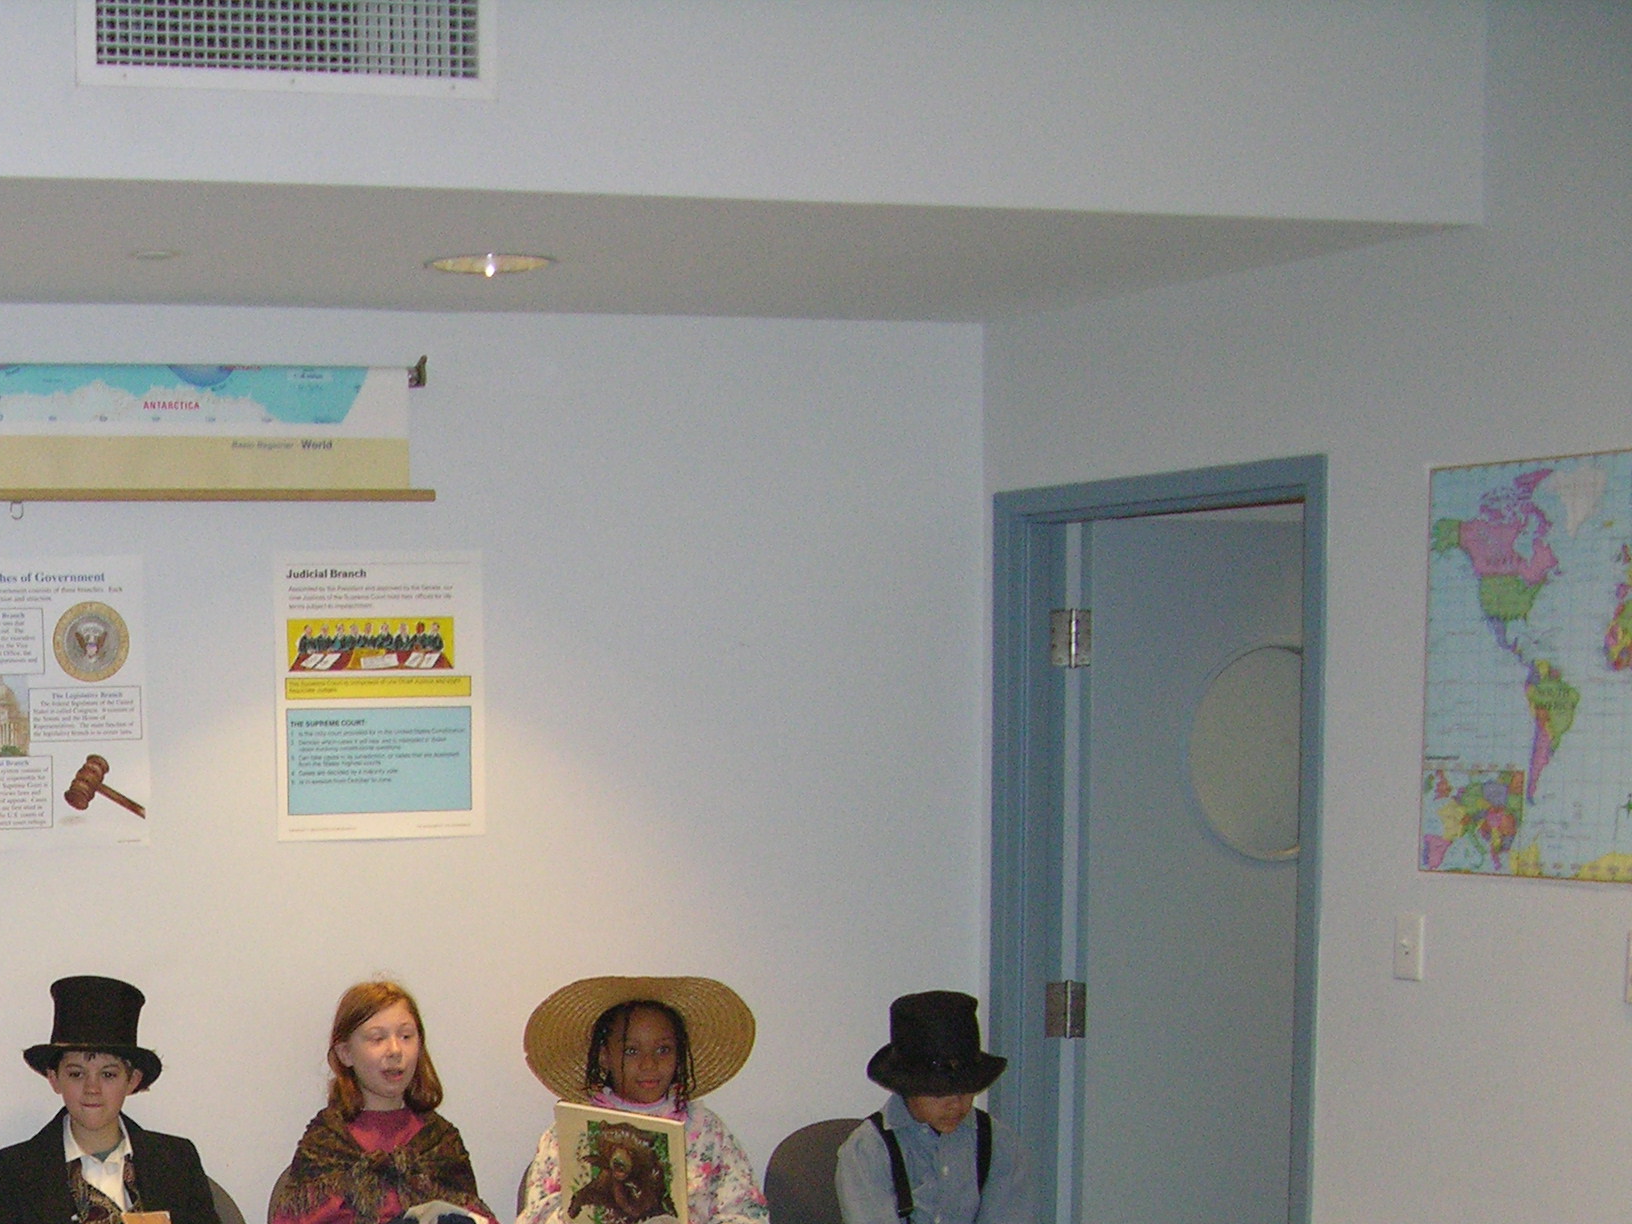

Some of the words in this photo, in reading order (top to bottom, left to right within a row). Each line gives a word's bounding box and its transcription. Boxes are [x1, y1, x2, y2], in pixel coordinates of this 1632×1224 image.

[143, 401, 200, 410] ANTARCTICA
[300, 439, 333, 450] World
[20, 572, 32, 582] of
[34, 571, 106, 583] Government
[286, 569, 328, 580] Judicial
[330, 568, 367, 579] Branch
[290, 720, 304, 728] THE
[305, 719, 340, 728] SUPREME
